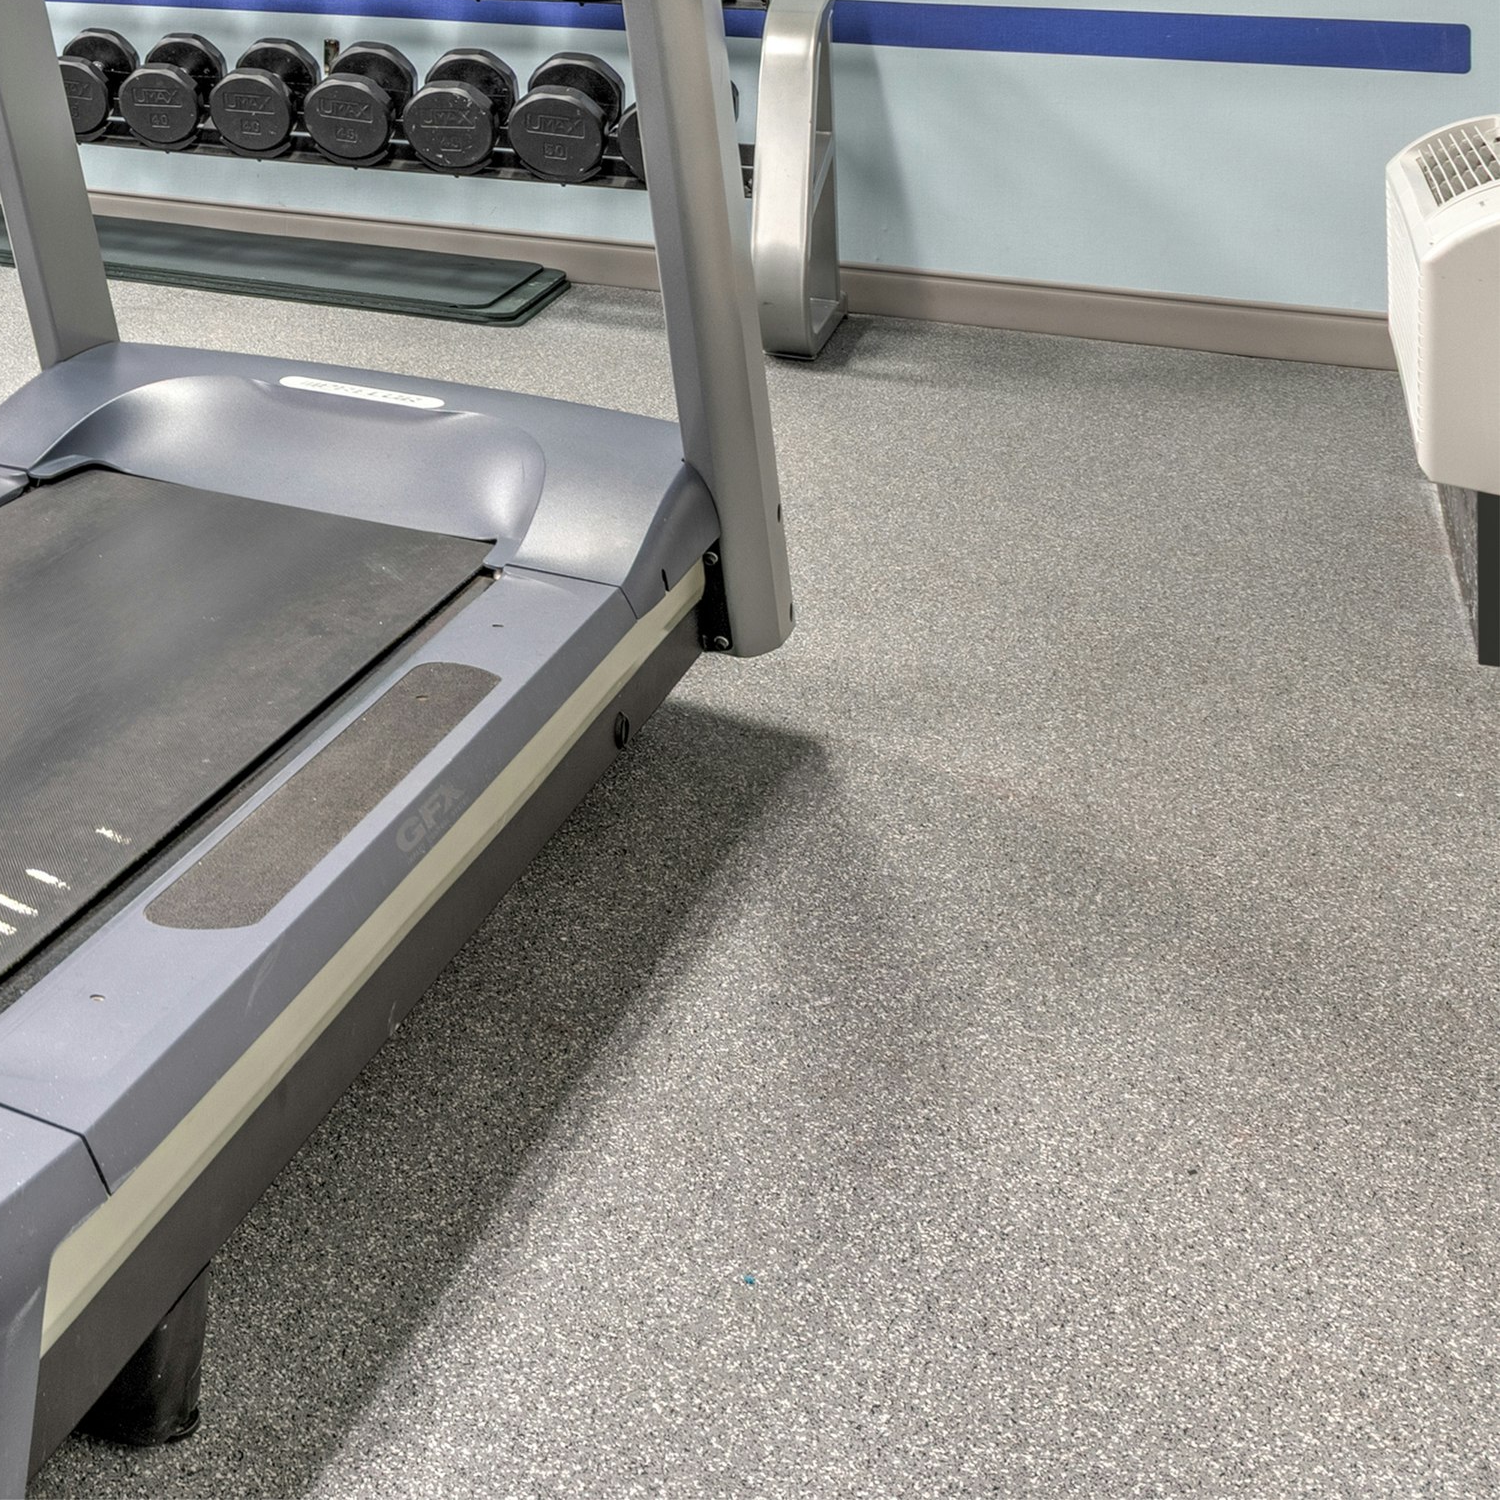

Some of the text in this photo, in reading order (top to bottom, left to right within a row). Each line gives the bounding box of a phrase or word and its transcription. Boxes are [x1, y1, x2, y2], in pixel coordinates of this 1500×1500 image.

[132, 88, 181, 105] UMAX
[224, 93, 275, 113] UMAX
[320, 99, 373, 120] UMAX
[421, 108, 475, 127] UMAX
[526, 114, 585, 136] UMAX
